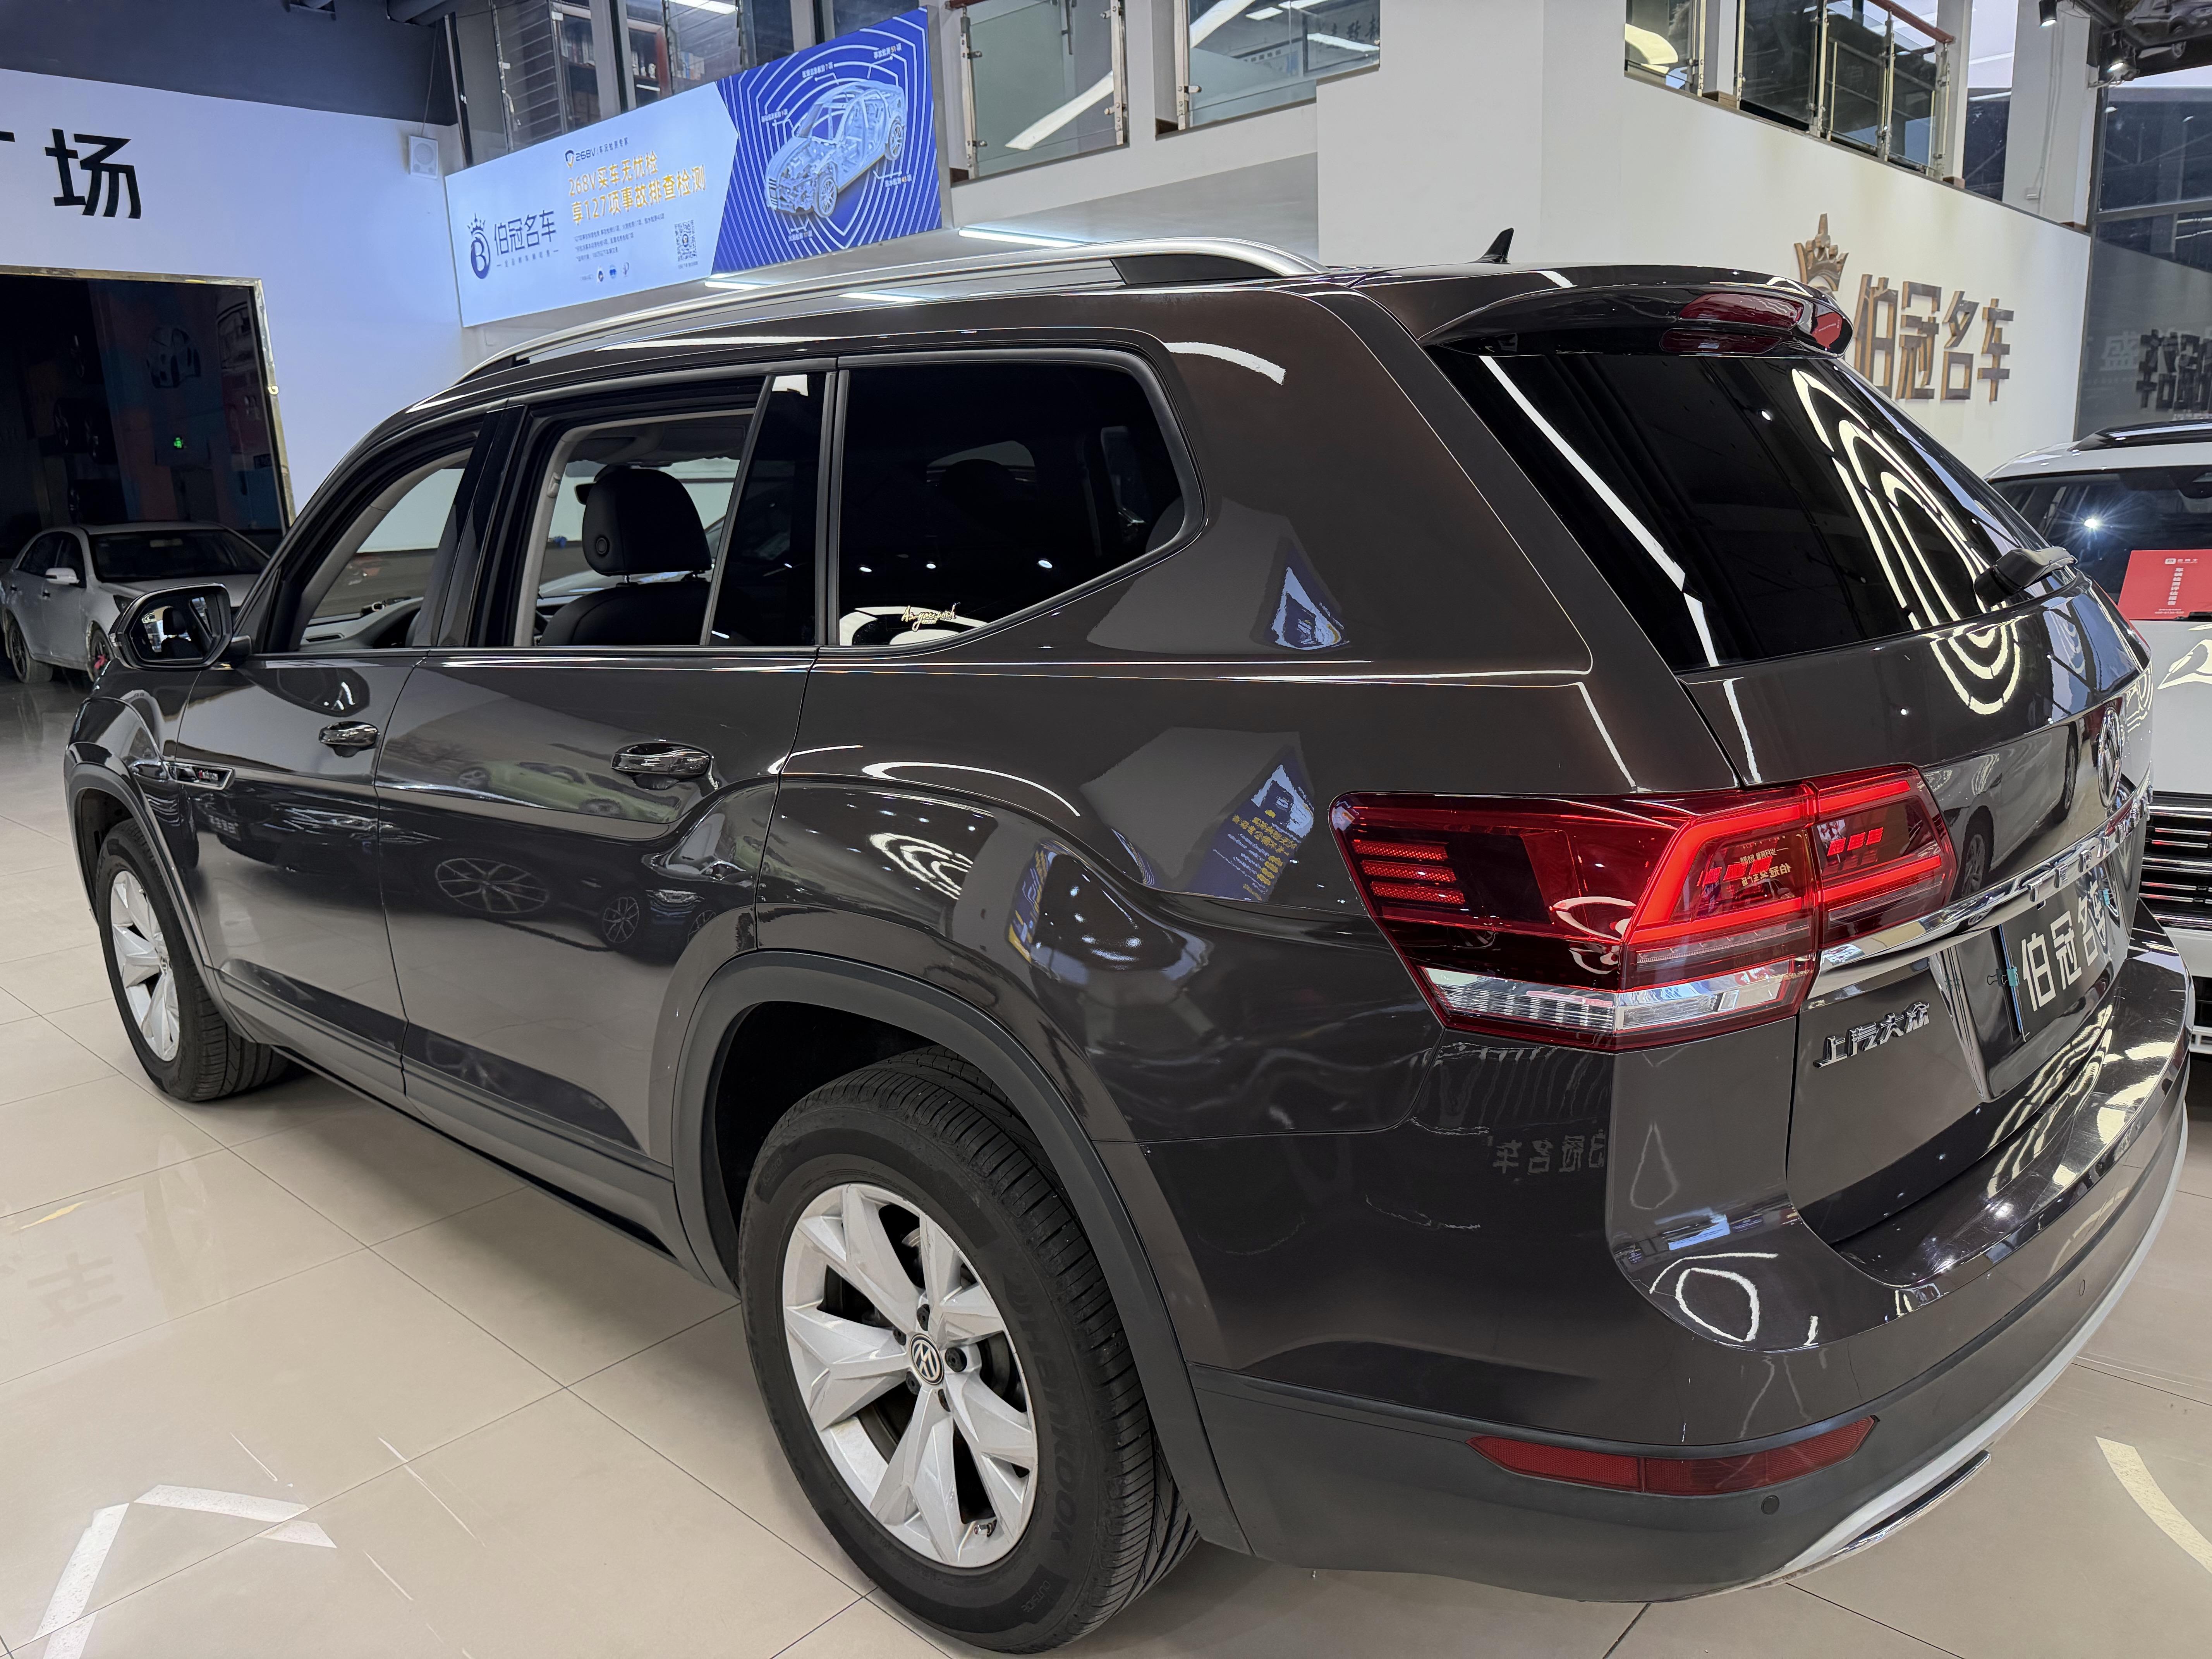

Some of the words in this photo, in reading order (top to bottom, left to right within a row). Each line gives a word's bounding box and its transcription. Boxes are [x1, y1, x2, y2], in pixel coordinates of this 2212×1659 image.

[568, 150, 658, 196] 268V买车无忧检
[571, 164, 706, 226] 享127项事故排查检测
[494, 210, 556, 256] 伯冠名车
[1854, 274, 2014, 402] 伯冠名车
[1813, 1001, 1930, 1068] 上汽大众
